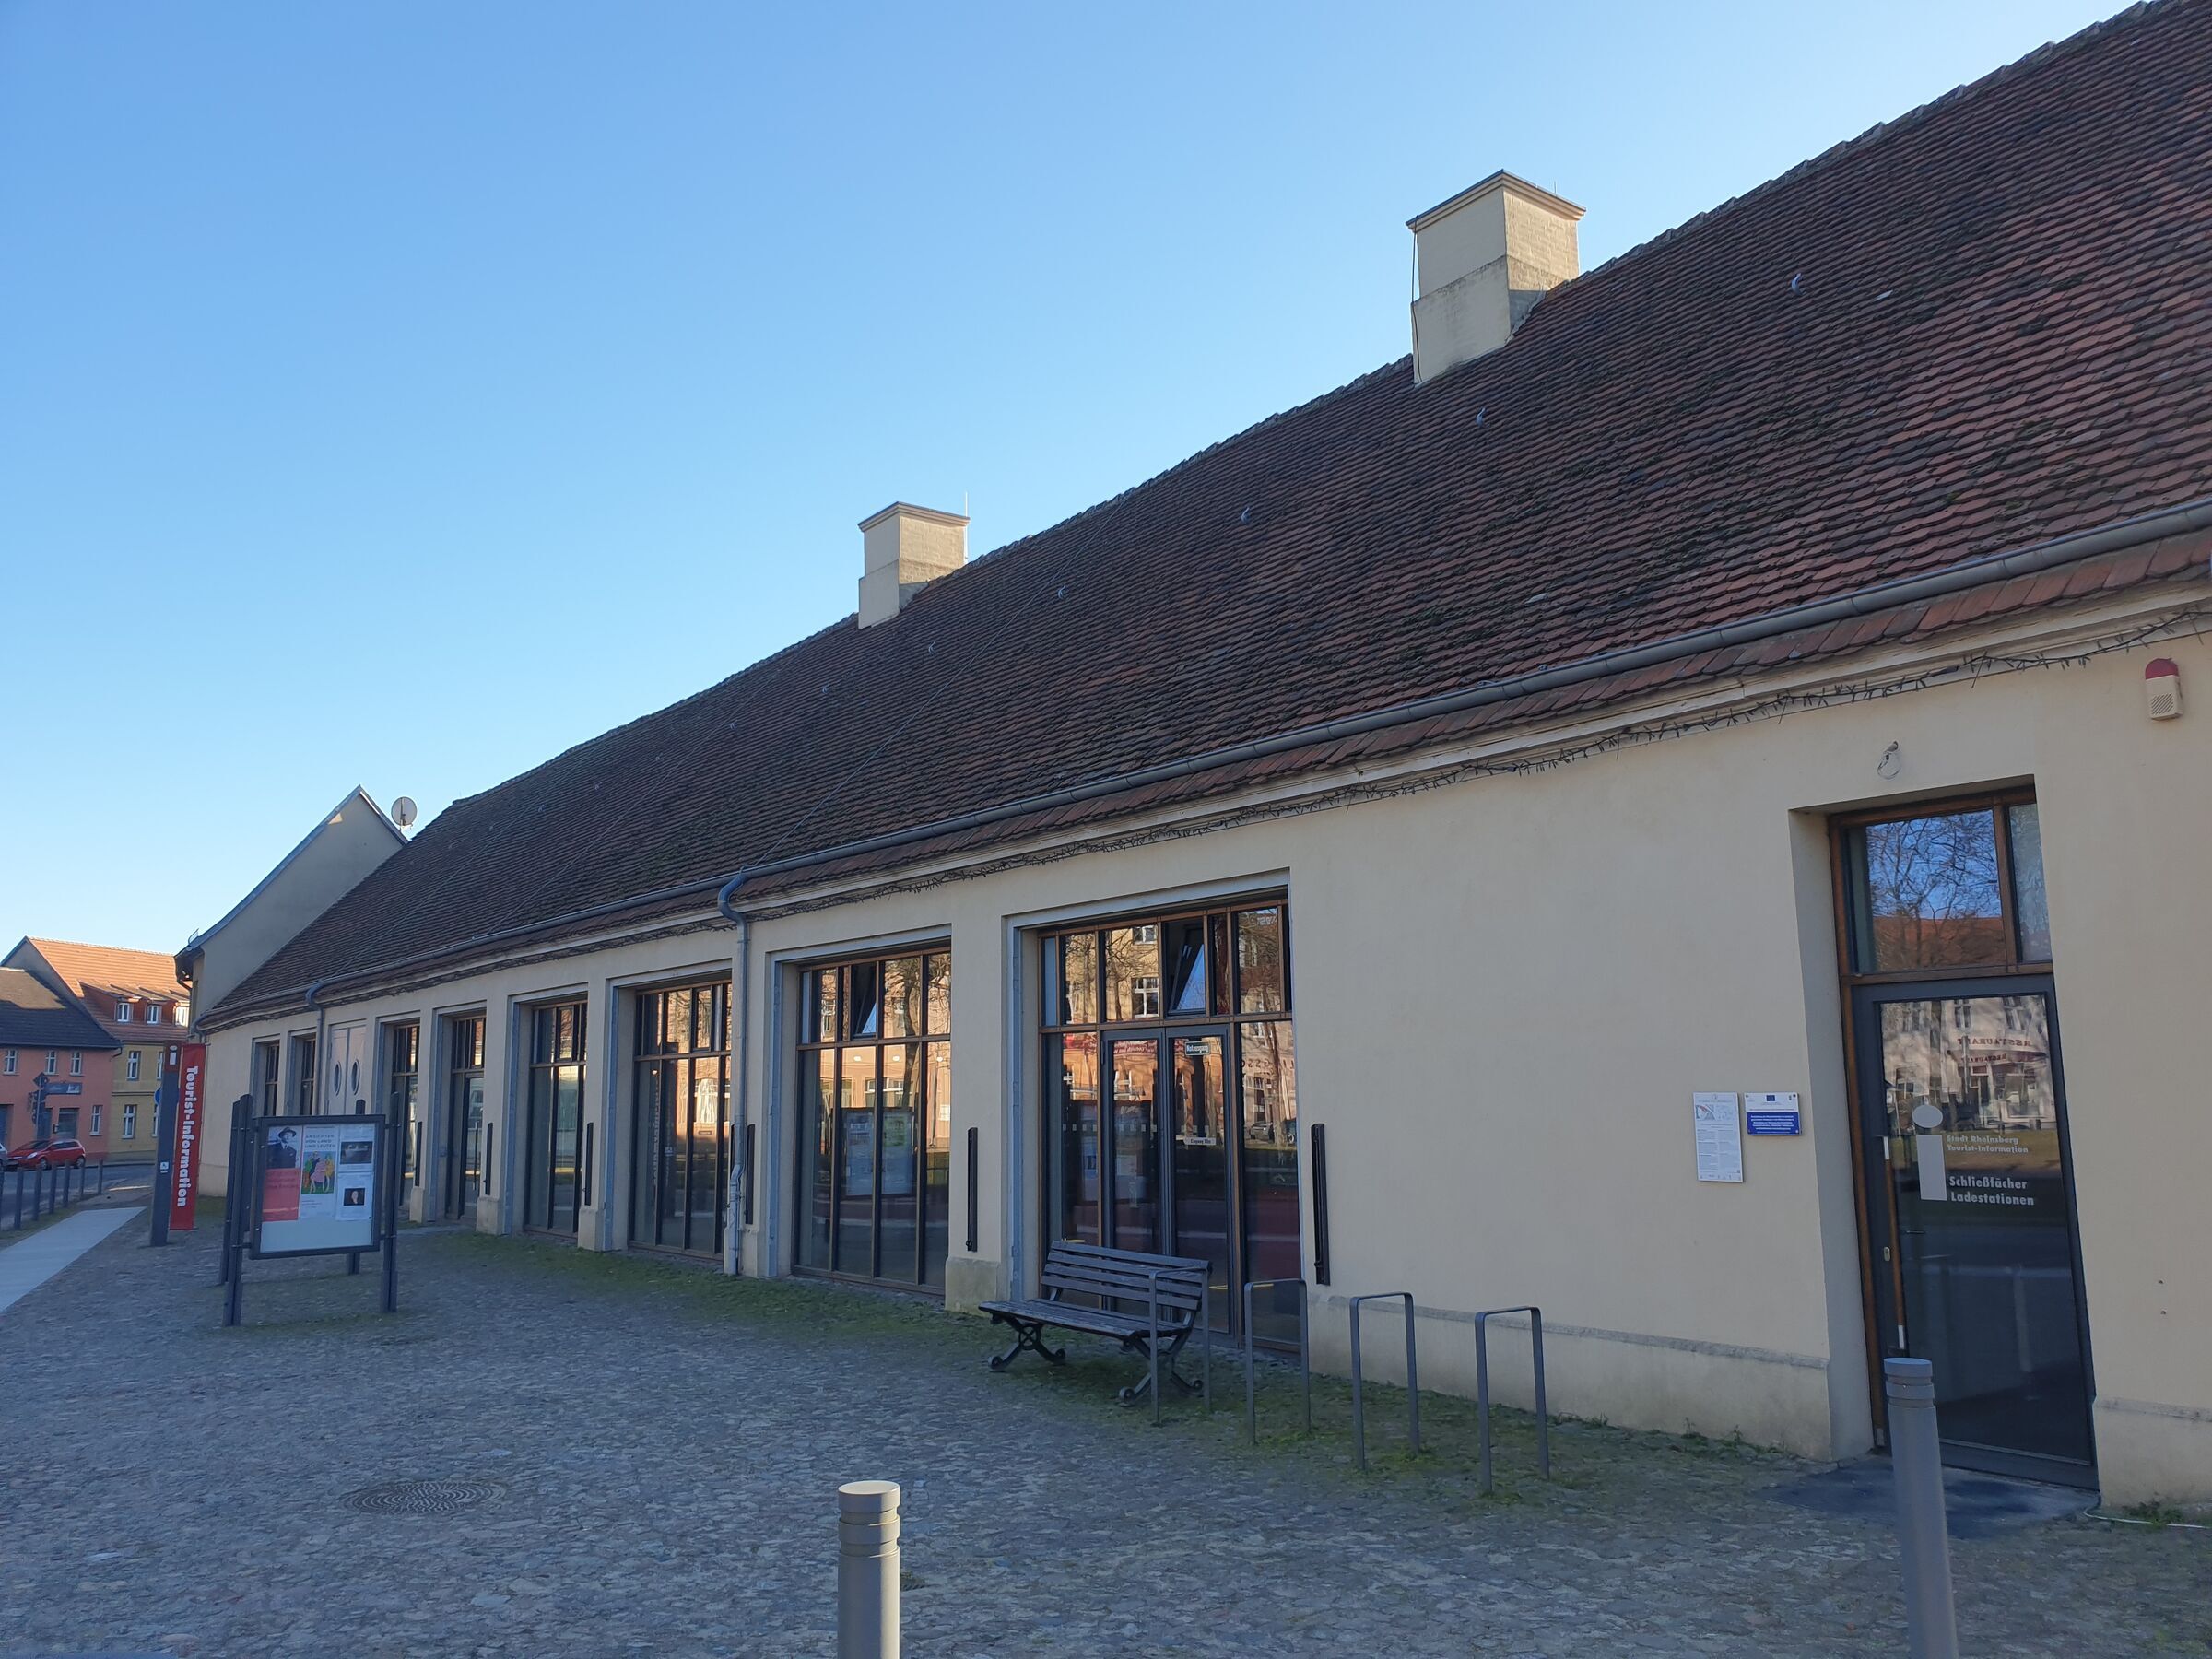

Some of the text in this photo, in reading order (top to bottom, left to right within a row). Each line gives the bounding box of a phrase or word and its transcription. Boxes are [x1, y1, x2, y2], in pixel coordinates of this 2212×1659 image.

[177, 1065, 199, 1207] Tourist-Information
[1971, 1135, 2019, 1145] Rheinsberg
[1947, 1144, 2029, 1154] Tourist-Information
[1949, 1176, 2028, 1189] Schließfächer
[1950, 1191, 2034, 1206] Ladestationen
